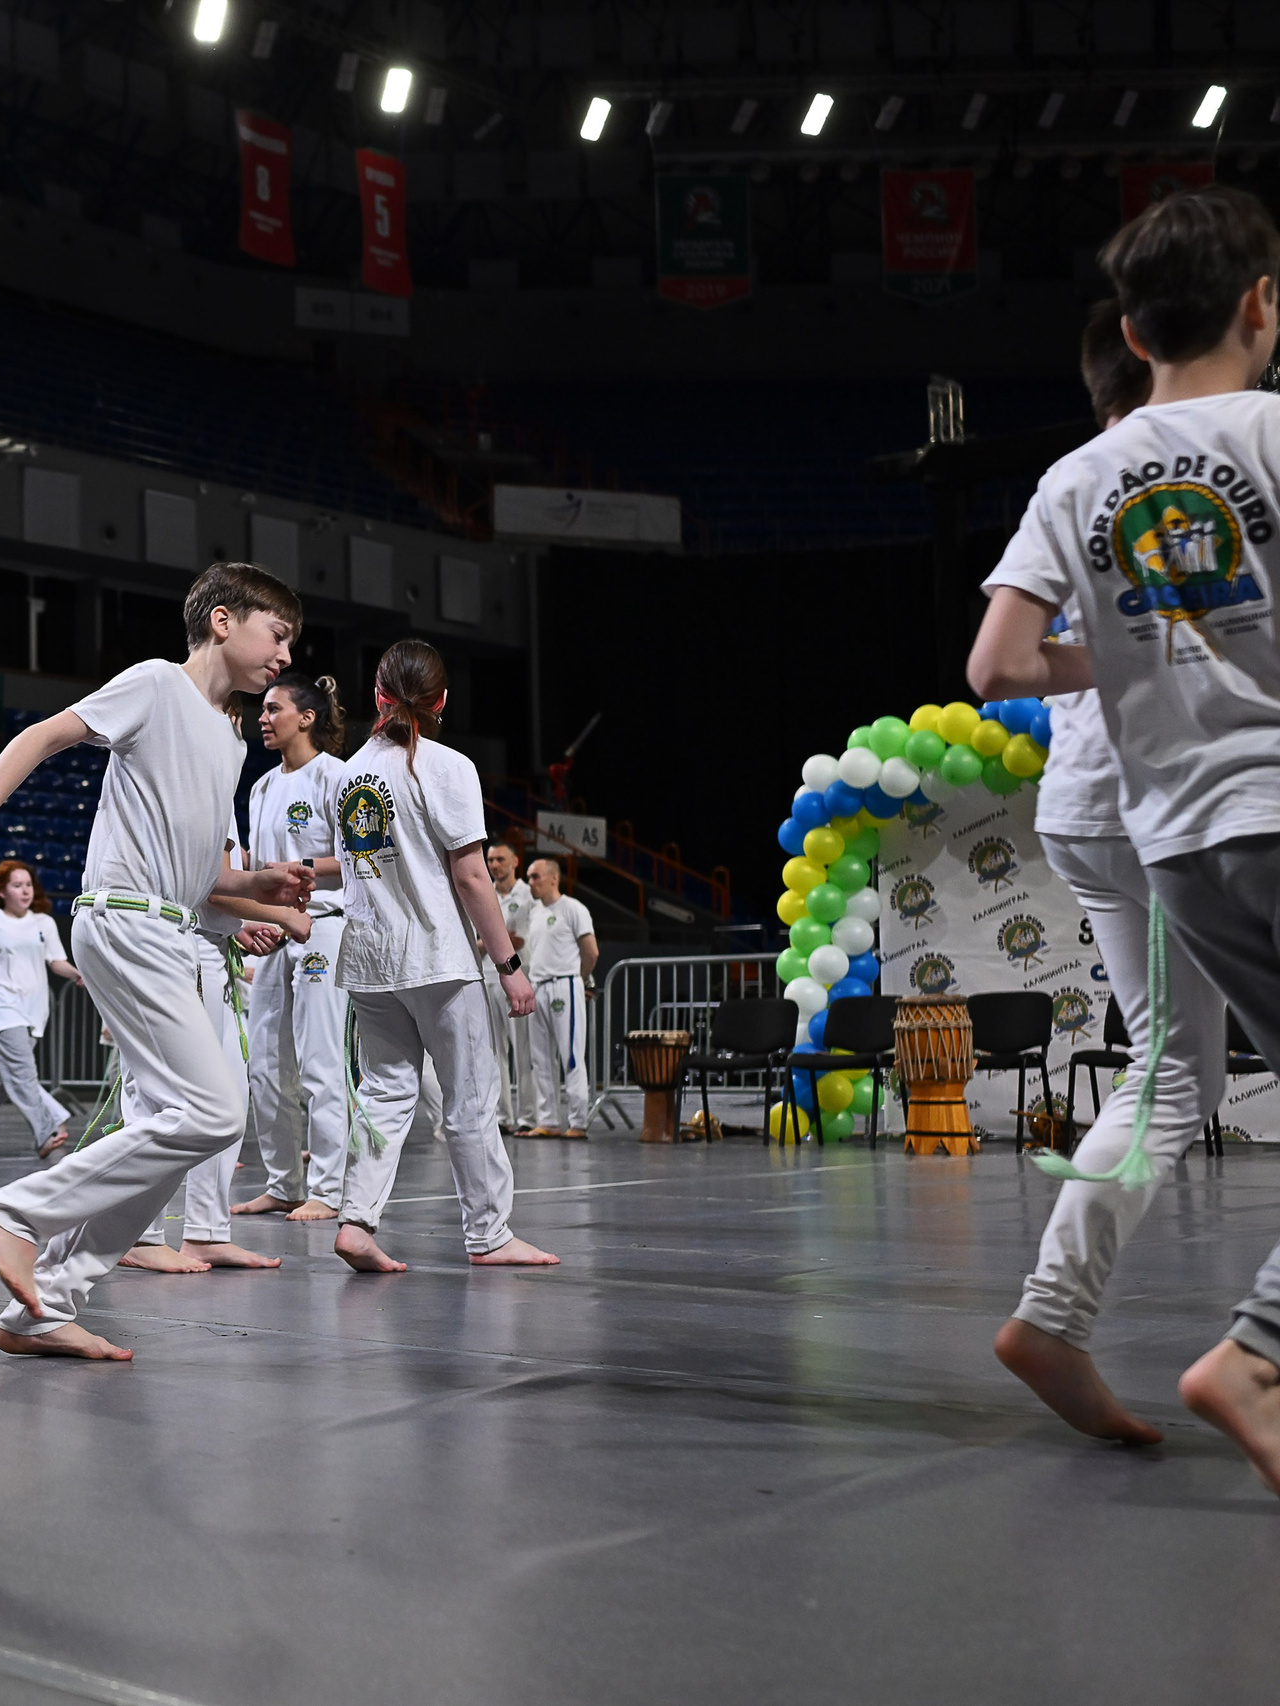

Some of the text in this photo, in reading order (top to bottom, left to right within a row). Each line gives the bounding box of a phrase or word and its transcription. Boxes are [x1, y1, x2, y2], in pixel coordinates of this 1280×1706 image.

[255, 163, 271, 202] 8
[373, 193, 391, 238] 5
[895, 231, 963, 244] ЧЕМПИОН
[902, 246, 958, 259] РОССИИ
[684, 282, 727, 299] 2019
[1089, 455, 1273, 573] CORDÃO DE OURO
[362, 772, 380, 786] DE
[952, 807, 1009, 840] КАЛИНИНГРАД
[972, 890, 1030, 926] КАЛИНИНГРАД
[1023, 959, 1082, 990] КАЛИНИНГРАД
[1227, 1080, 1279, 1107] КАЛИНИНГР
